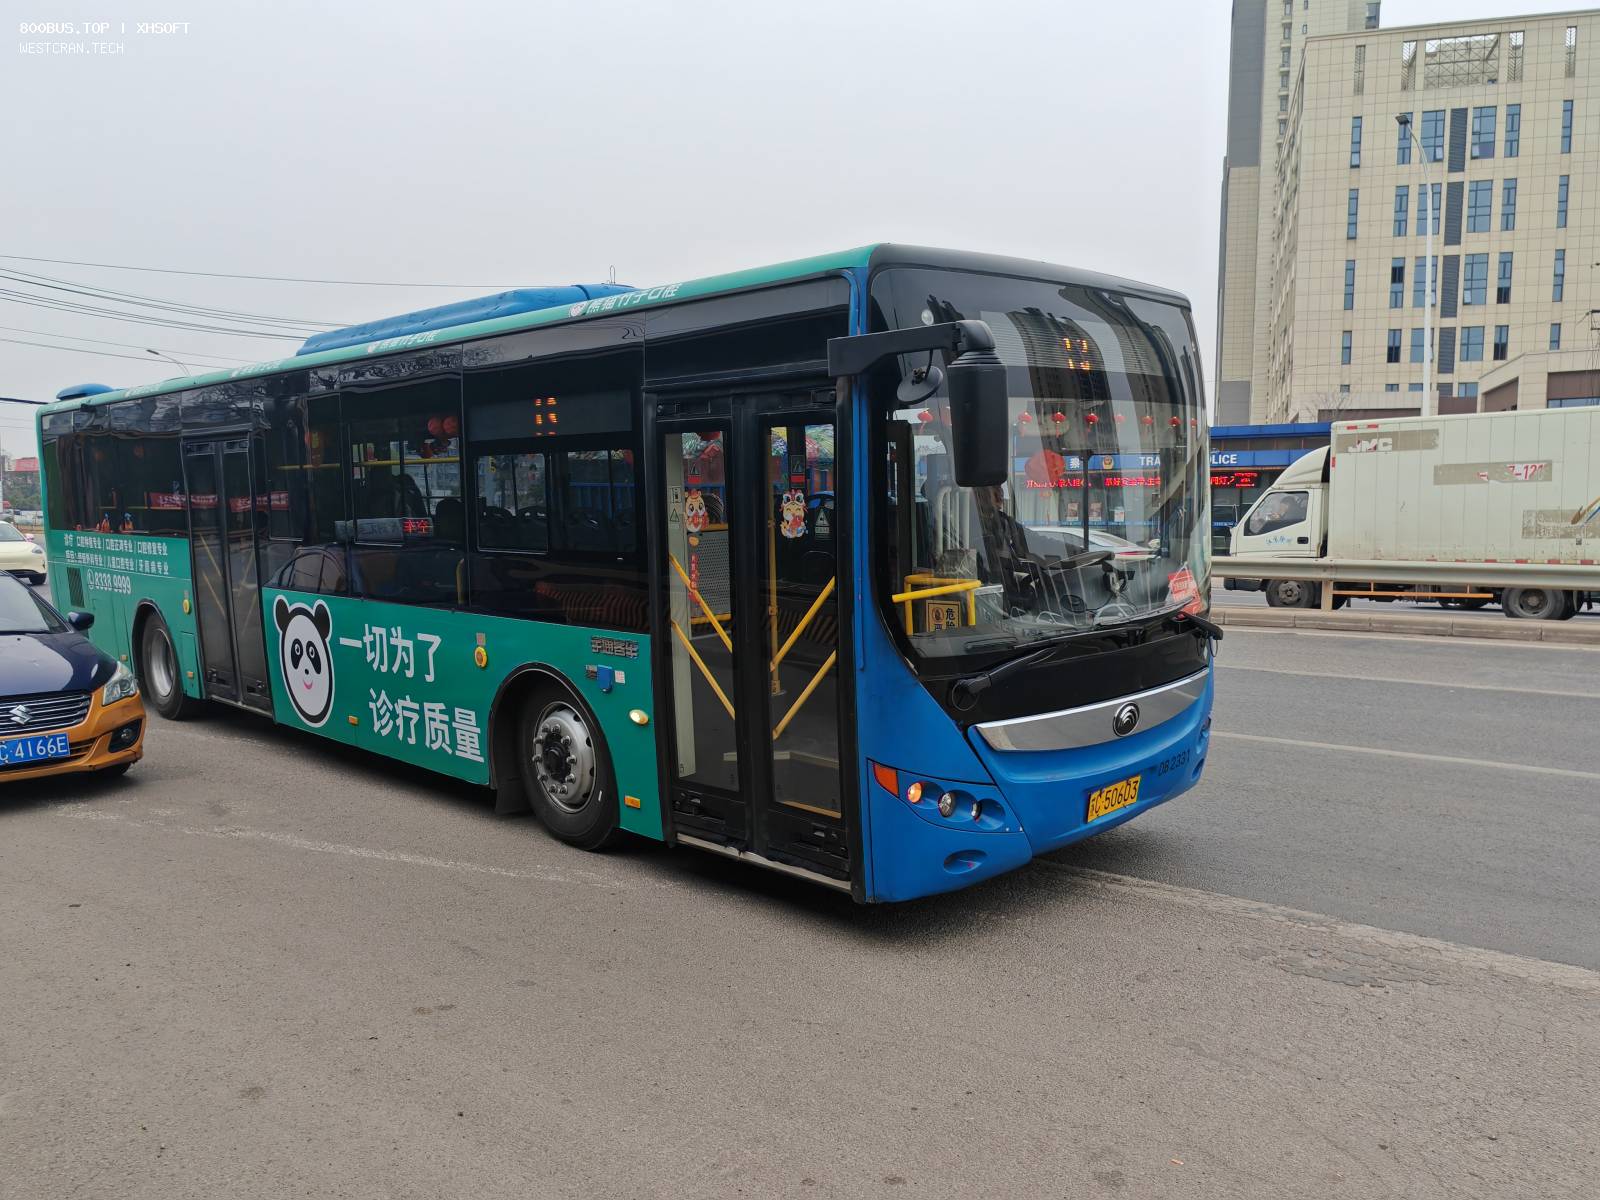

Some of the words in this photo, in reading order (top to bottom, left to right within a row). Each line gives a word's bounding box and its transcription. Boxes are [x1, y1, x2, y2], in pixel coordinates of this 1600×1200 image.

[1210, 454, 1237, 465] LICE
[339, 624, 442, 683] 一切为了
[368, 688, 485, 764] 诊疗质量
